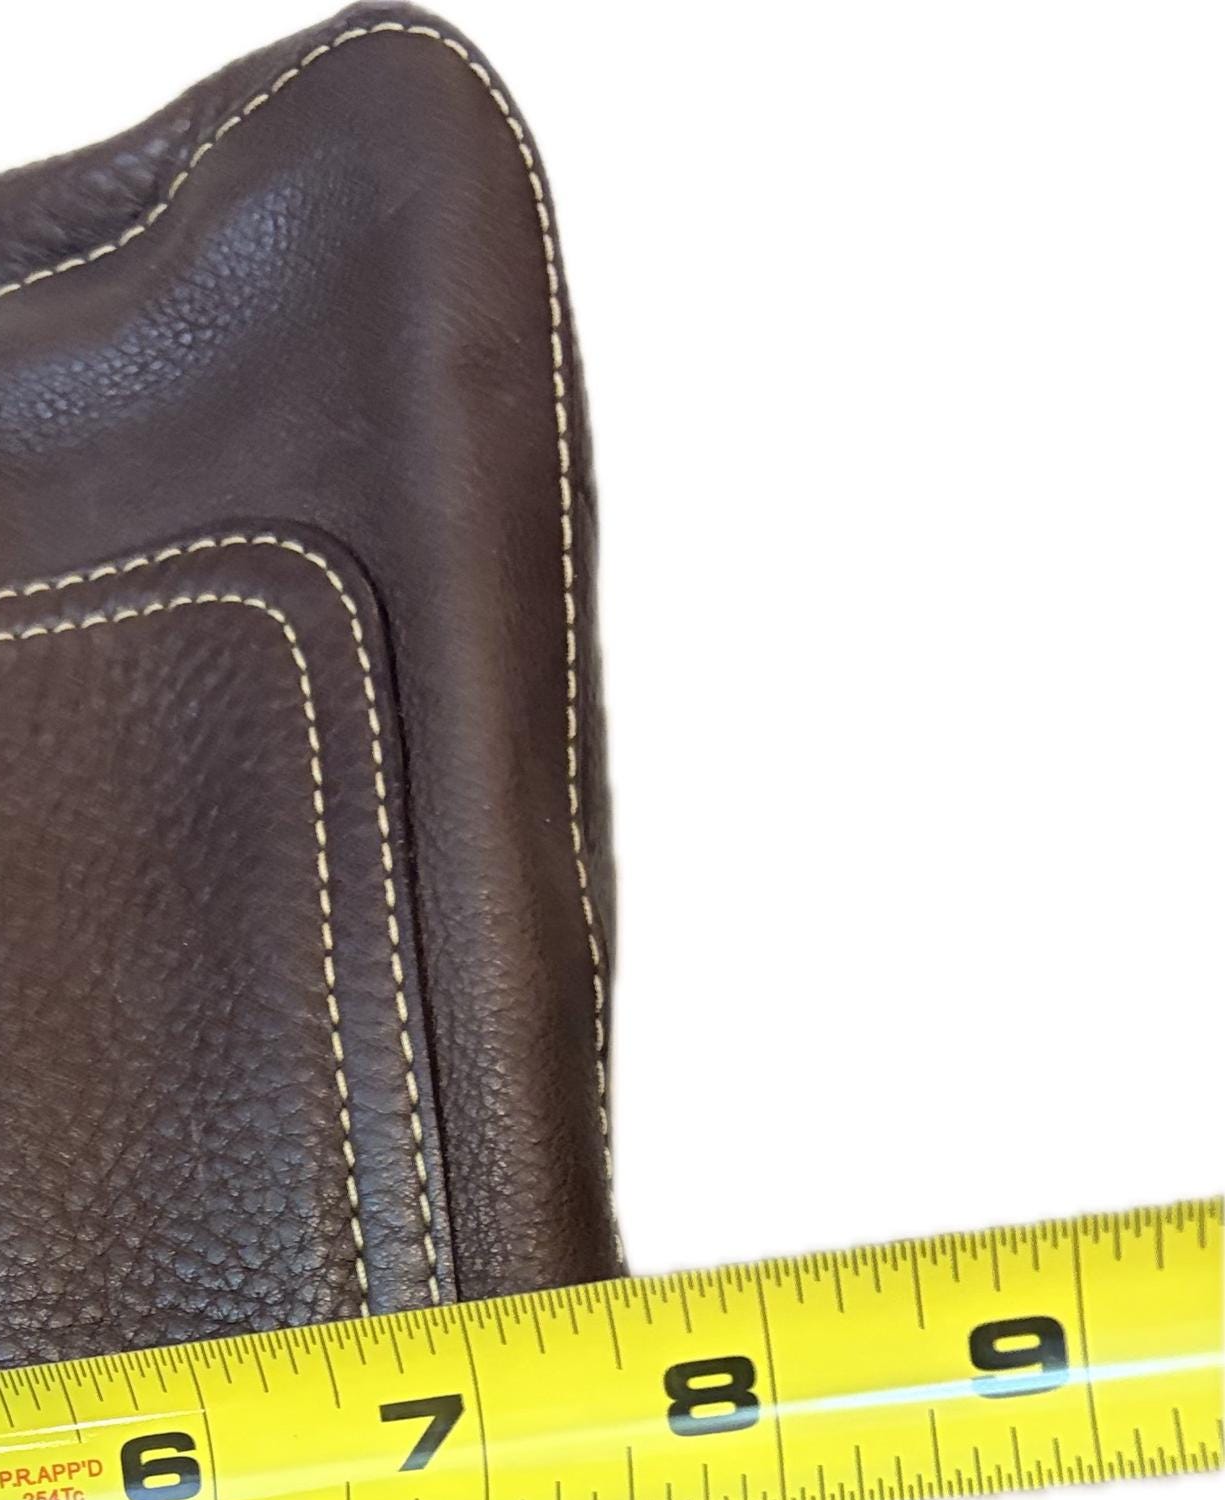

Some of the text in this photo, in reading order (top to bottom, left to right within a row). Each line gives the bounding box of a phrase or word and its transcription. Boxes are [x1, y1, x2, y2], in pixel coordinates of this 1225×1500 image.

[663, 1355, 761, 1437] 8
[968, 1315, 1070, 1399] 9
[380, 1394, 465, 1472] 7
